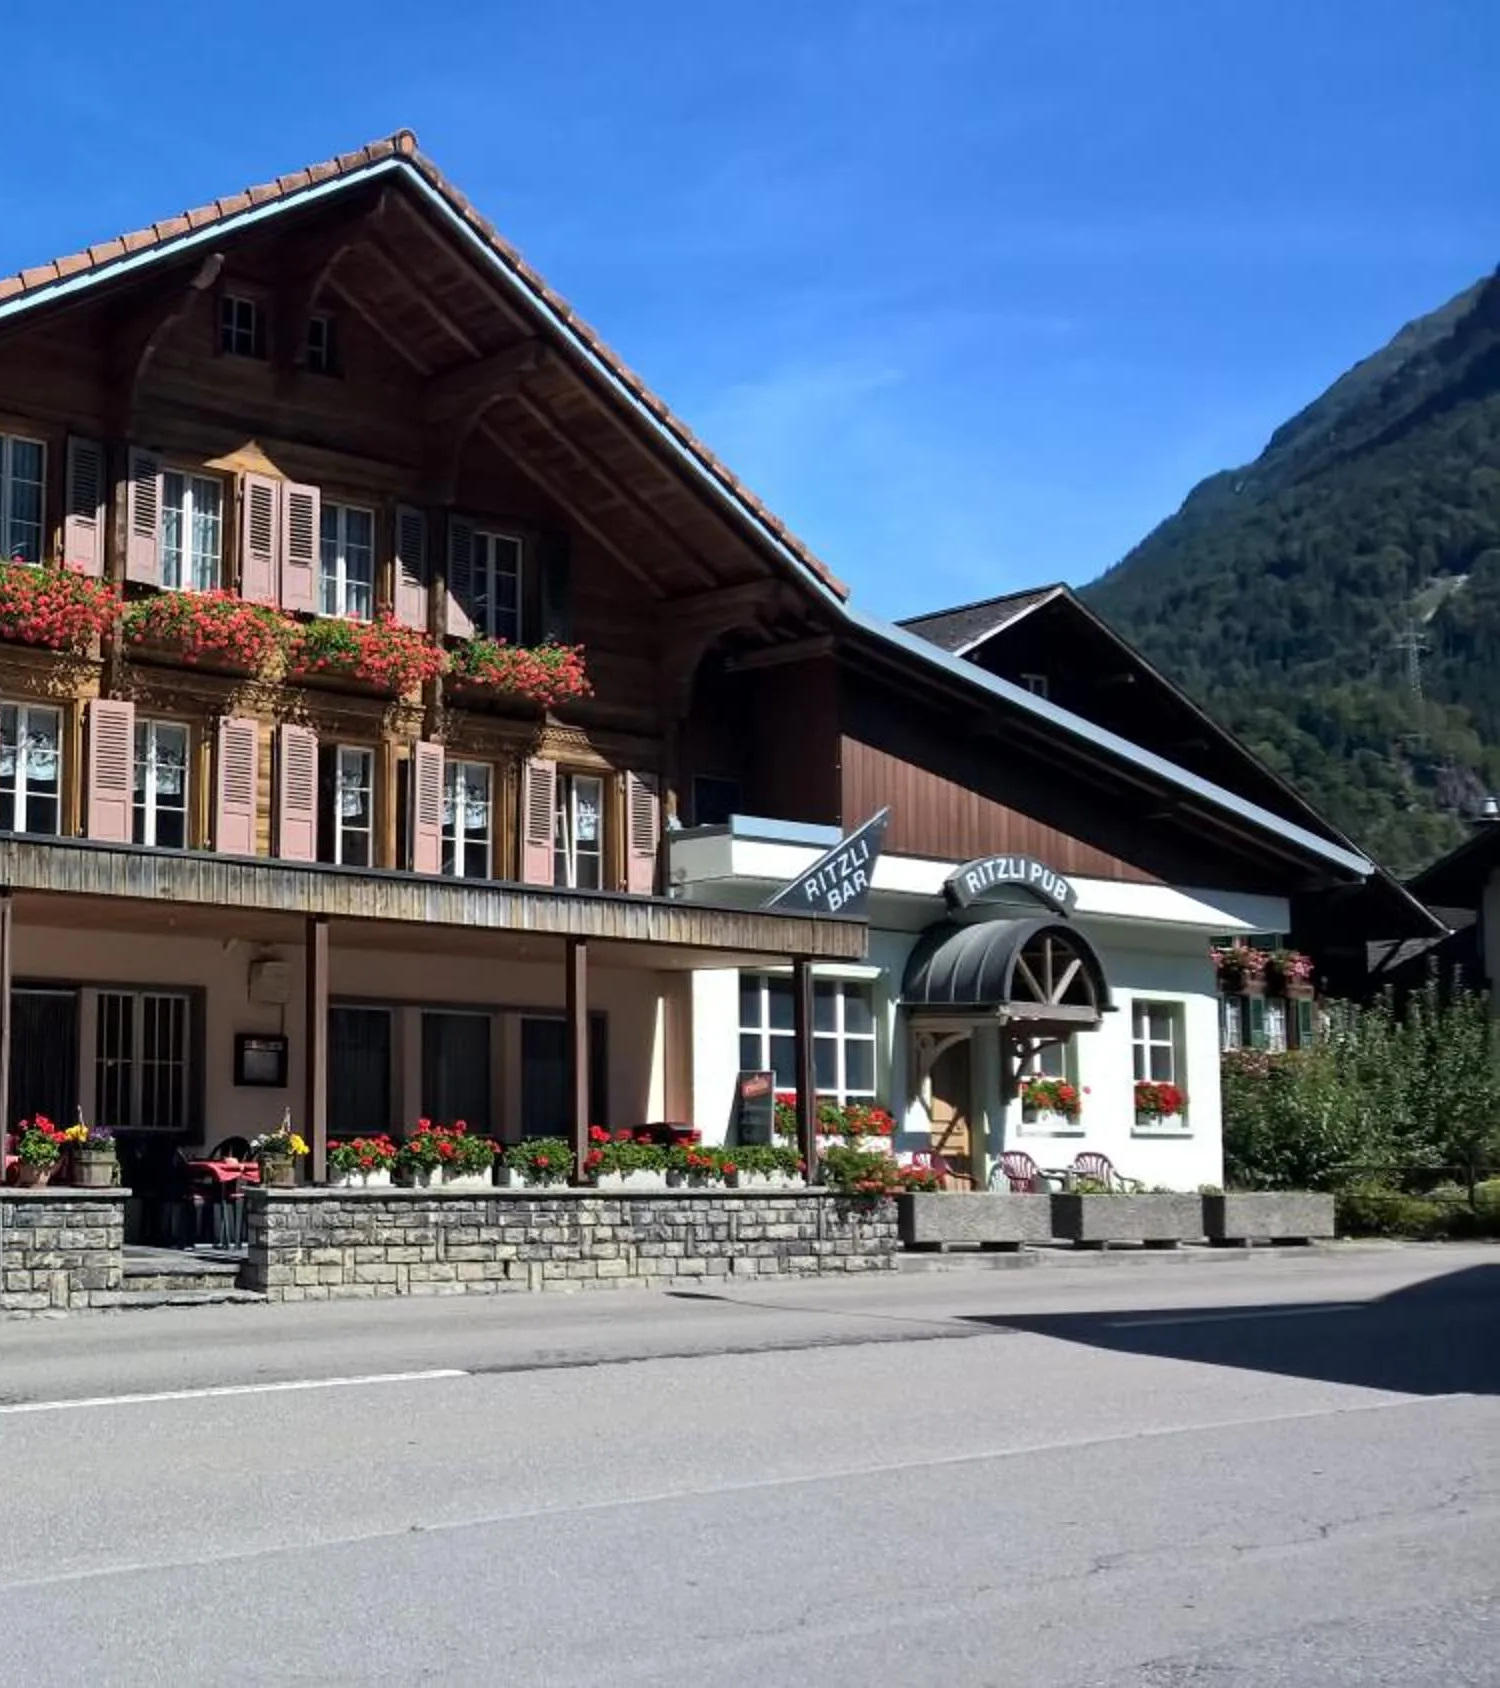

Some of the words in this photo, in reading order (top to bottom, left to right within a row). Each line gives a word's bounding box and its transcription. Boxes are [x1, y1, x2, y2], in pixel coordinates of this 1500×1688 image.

[804, 839, 869, 902] RITZLI
[827, 869, 868, 912] BAR
[965, 857, 1025, 893] RITZLI
[1029, 862, 1067, 901] PUB
